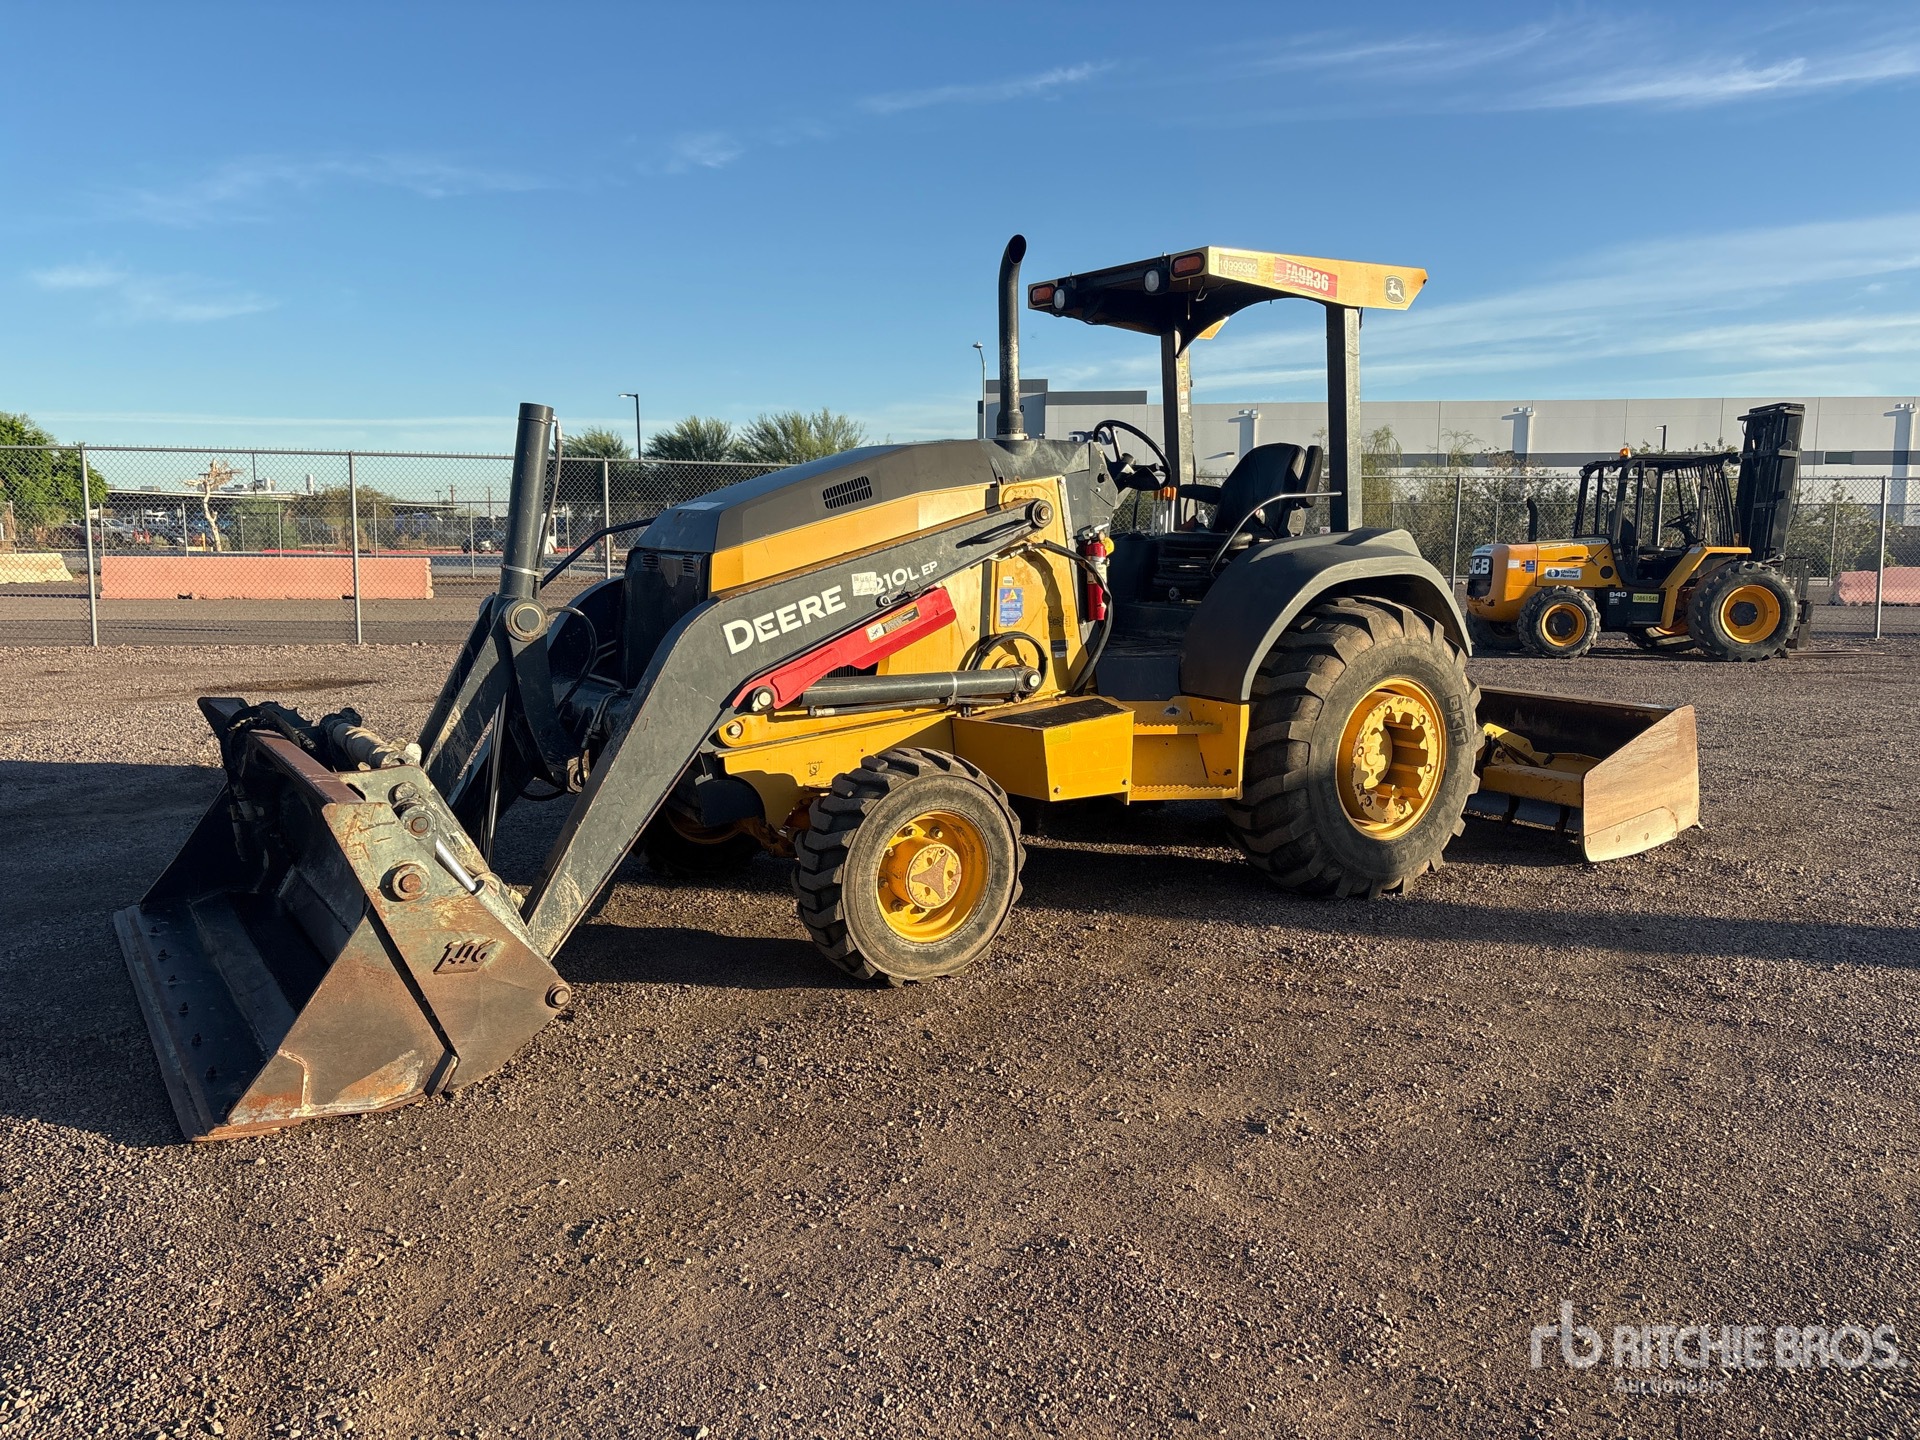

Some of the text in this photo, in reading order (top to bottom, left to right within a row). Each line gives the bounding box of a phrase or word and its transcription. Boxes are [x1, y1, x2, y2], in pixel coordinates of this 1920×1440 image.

[873, 567, 920, 596] 210L
[921, 561, 938, 576] EP
[1469, 558, 1490, 575] JCB
[723, 585, 847, 655] DEERE
[1445, 694, 1469, 746] BKT
